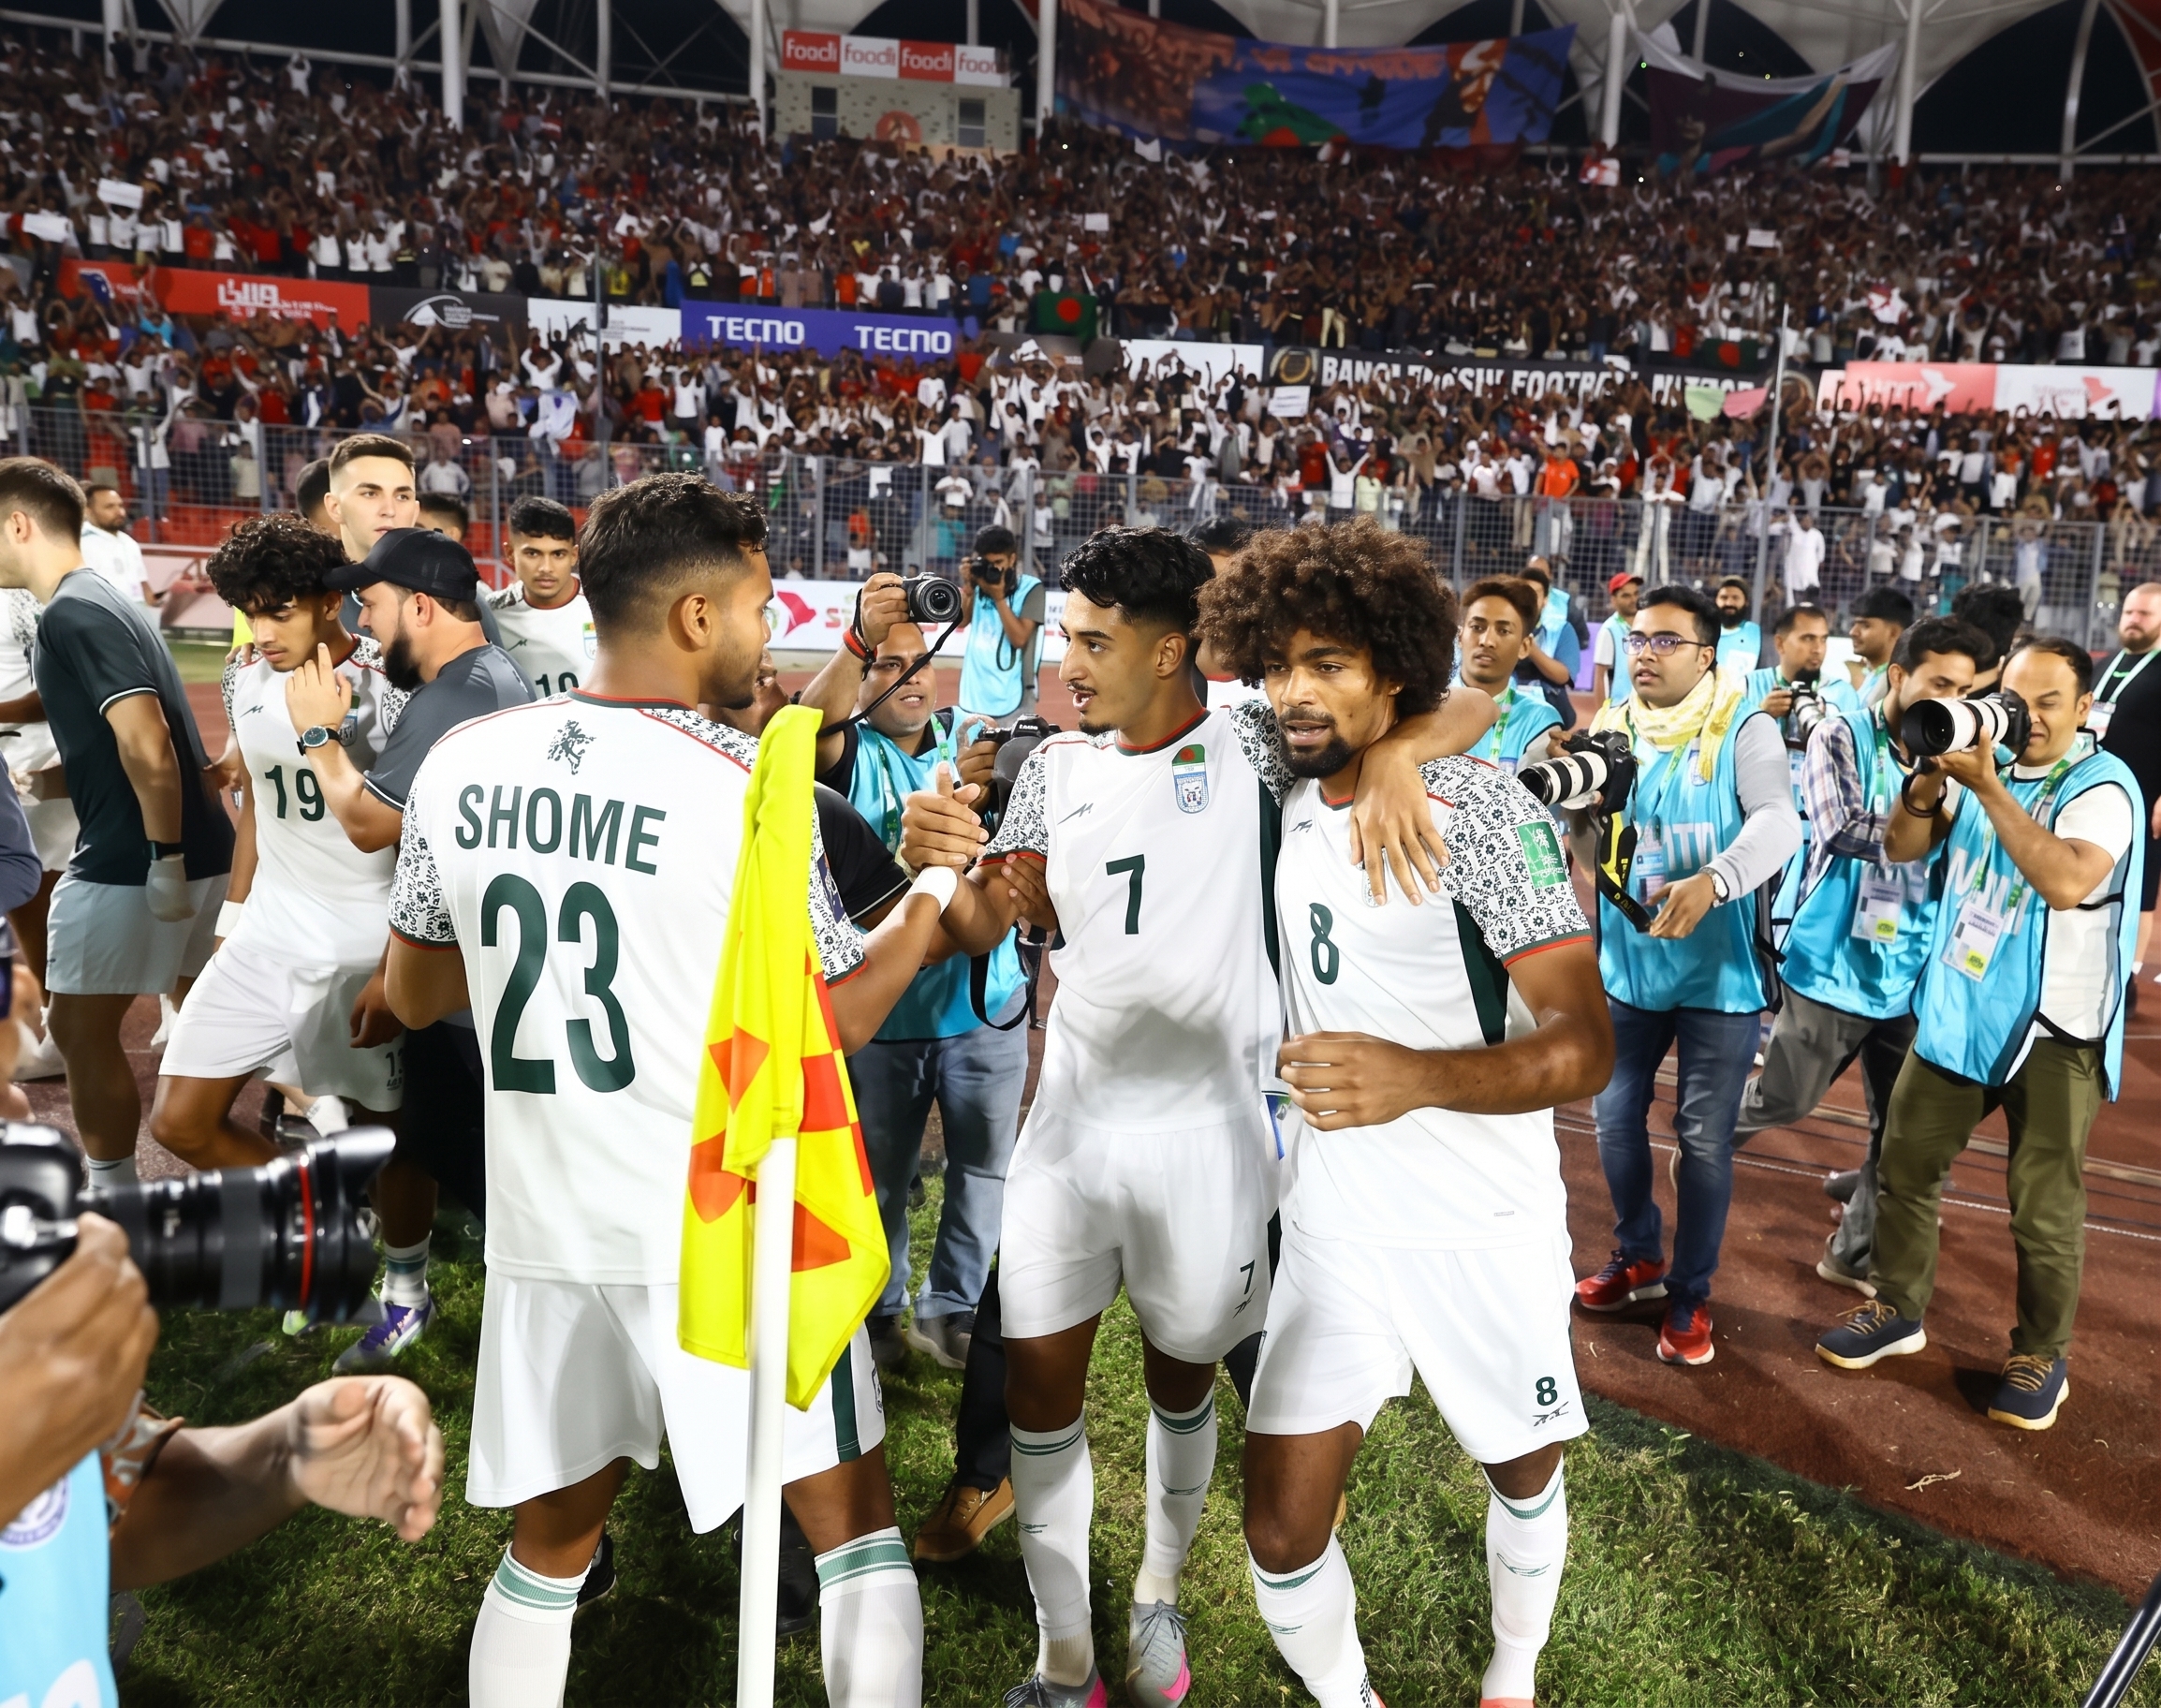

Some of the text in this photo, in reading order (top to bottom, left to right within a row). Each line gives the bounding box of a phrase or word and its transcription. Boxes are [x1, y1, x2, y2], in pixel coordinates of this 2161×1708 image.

[786, 38, 837, 63] foodi
[902, 47, 952, 71] foodi
[706, 316, 952, 354] TECNO TECNO
[264, 764, 325, 822] 19
[455, 784, 667, 876] SHOME
[1106, 854, 1145, 935] 7
[1309, 903, 1339, 985] 8
[481, 873, 636, 1095] 23
[1240, 1259, 1255, 1295] 7
[1536, 1376, 1558, 1406] 8
